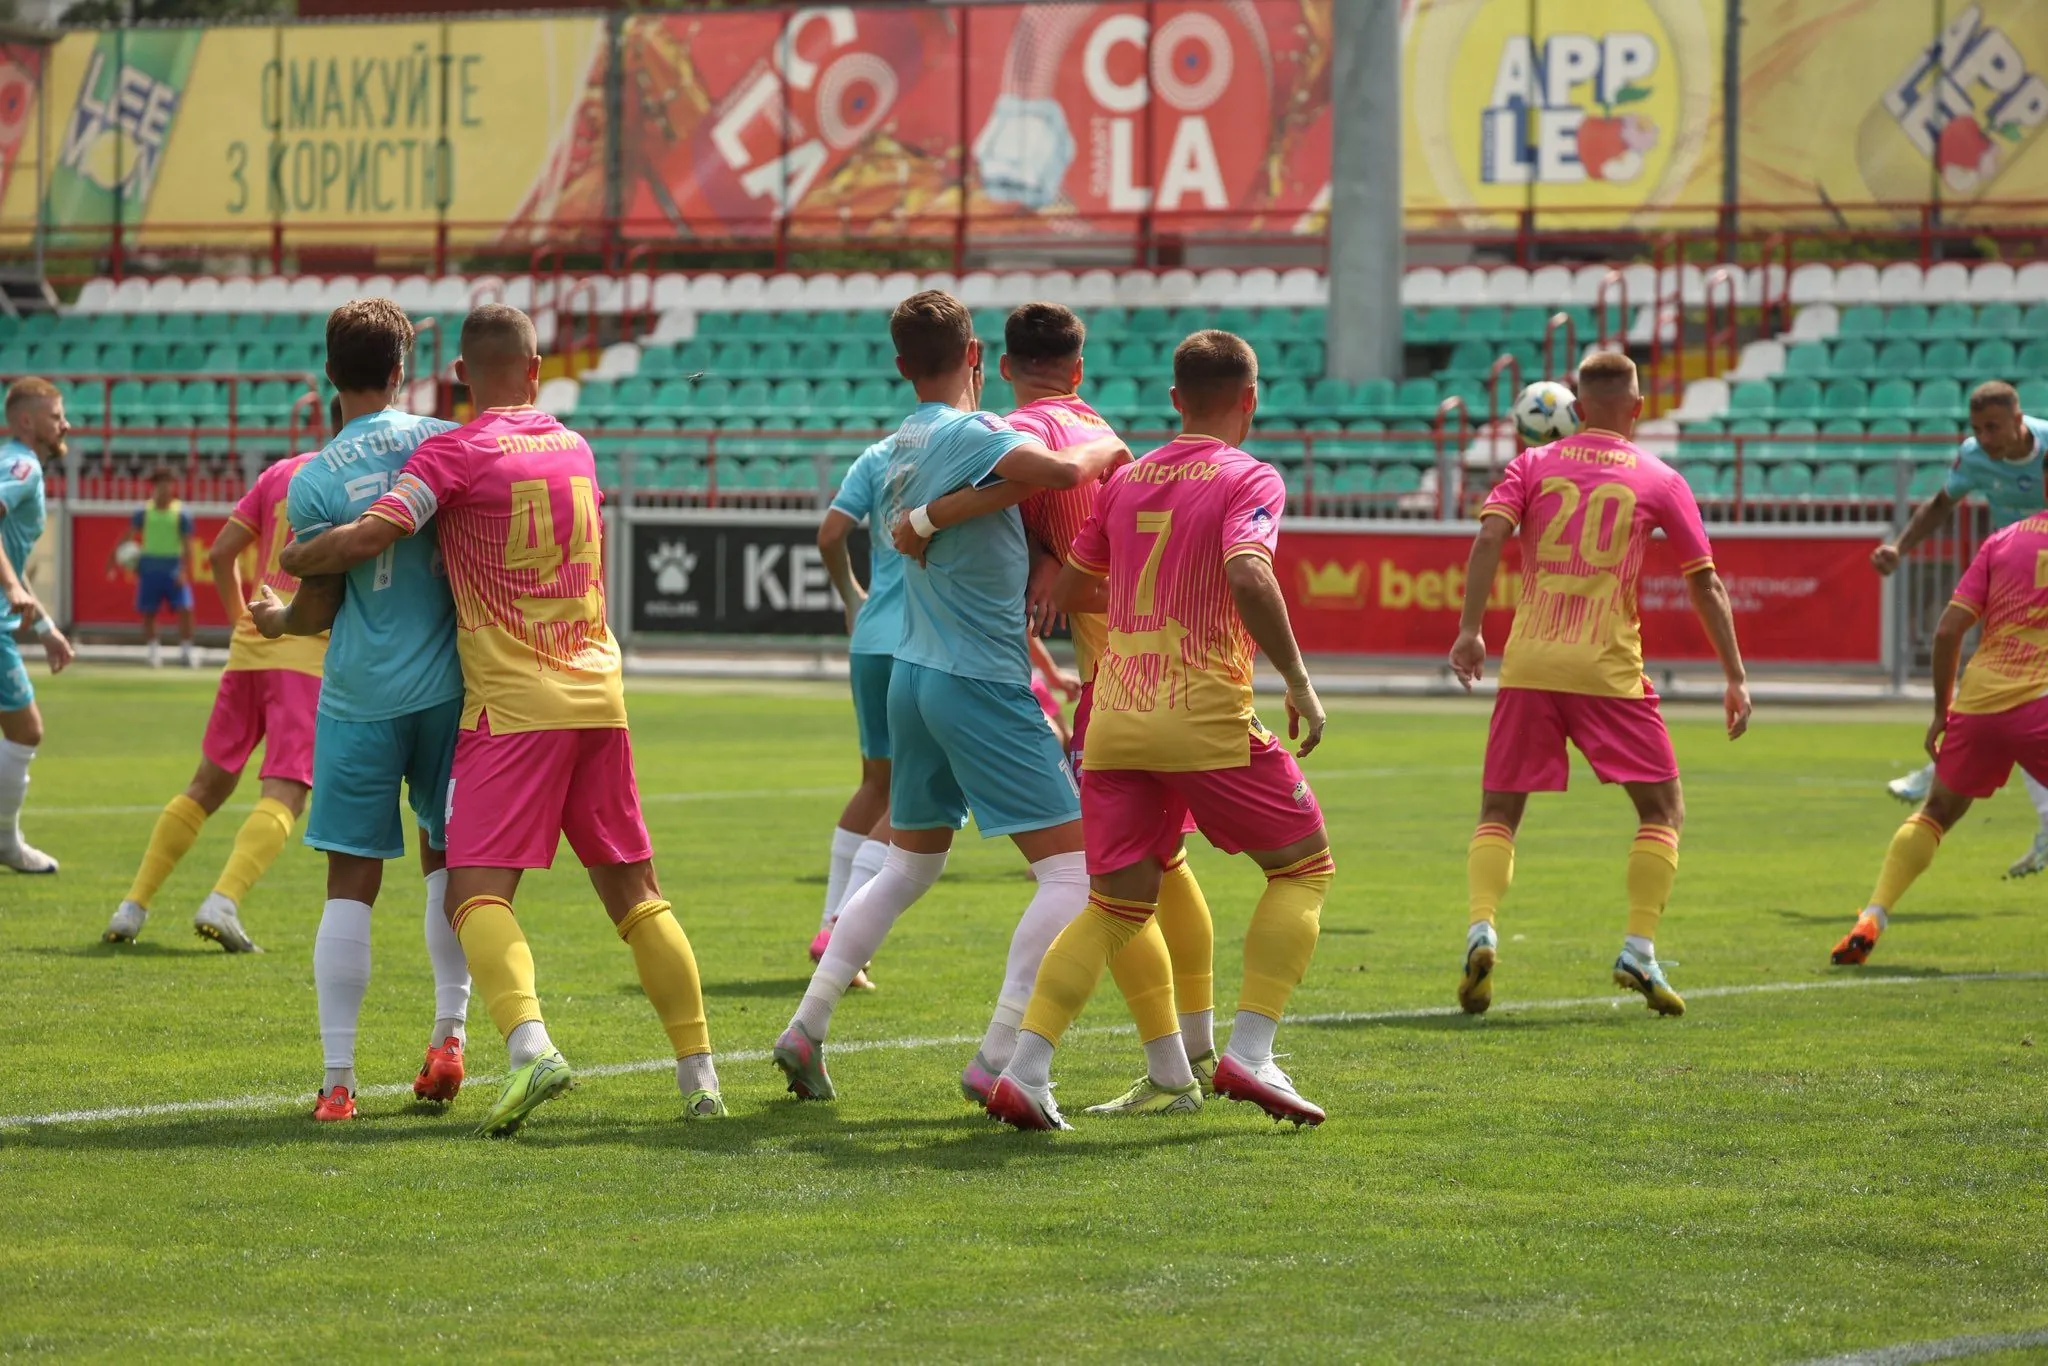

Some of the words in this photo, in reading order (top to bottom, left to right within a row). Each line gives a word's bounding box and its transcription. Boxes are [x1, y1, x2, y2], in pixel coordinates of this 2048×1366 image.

[260, 43, 484, 131] СМАКУЙТЕ
[1083, 13, 1233, 111] CO
[1490, 33, 1659, 108] APP
[266, 139, 456, 214] КОРИСТЮ
[1109, 115, 1229, 211] LA
[505, 476, 600, 584] 44
[1134, 509, 1175, 616] 7
[1537, 476, 1638, 568] 20
